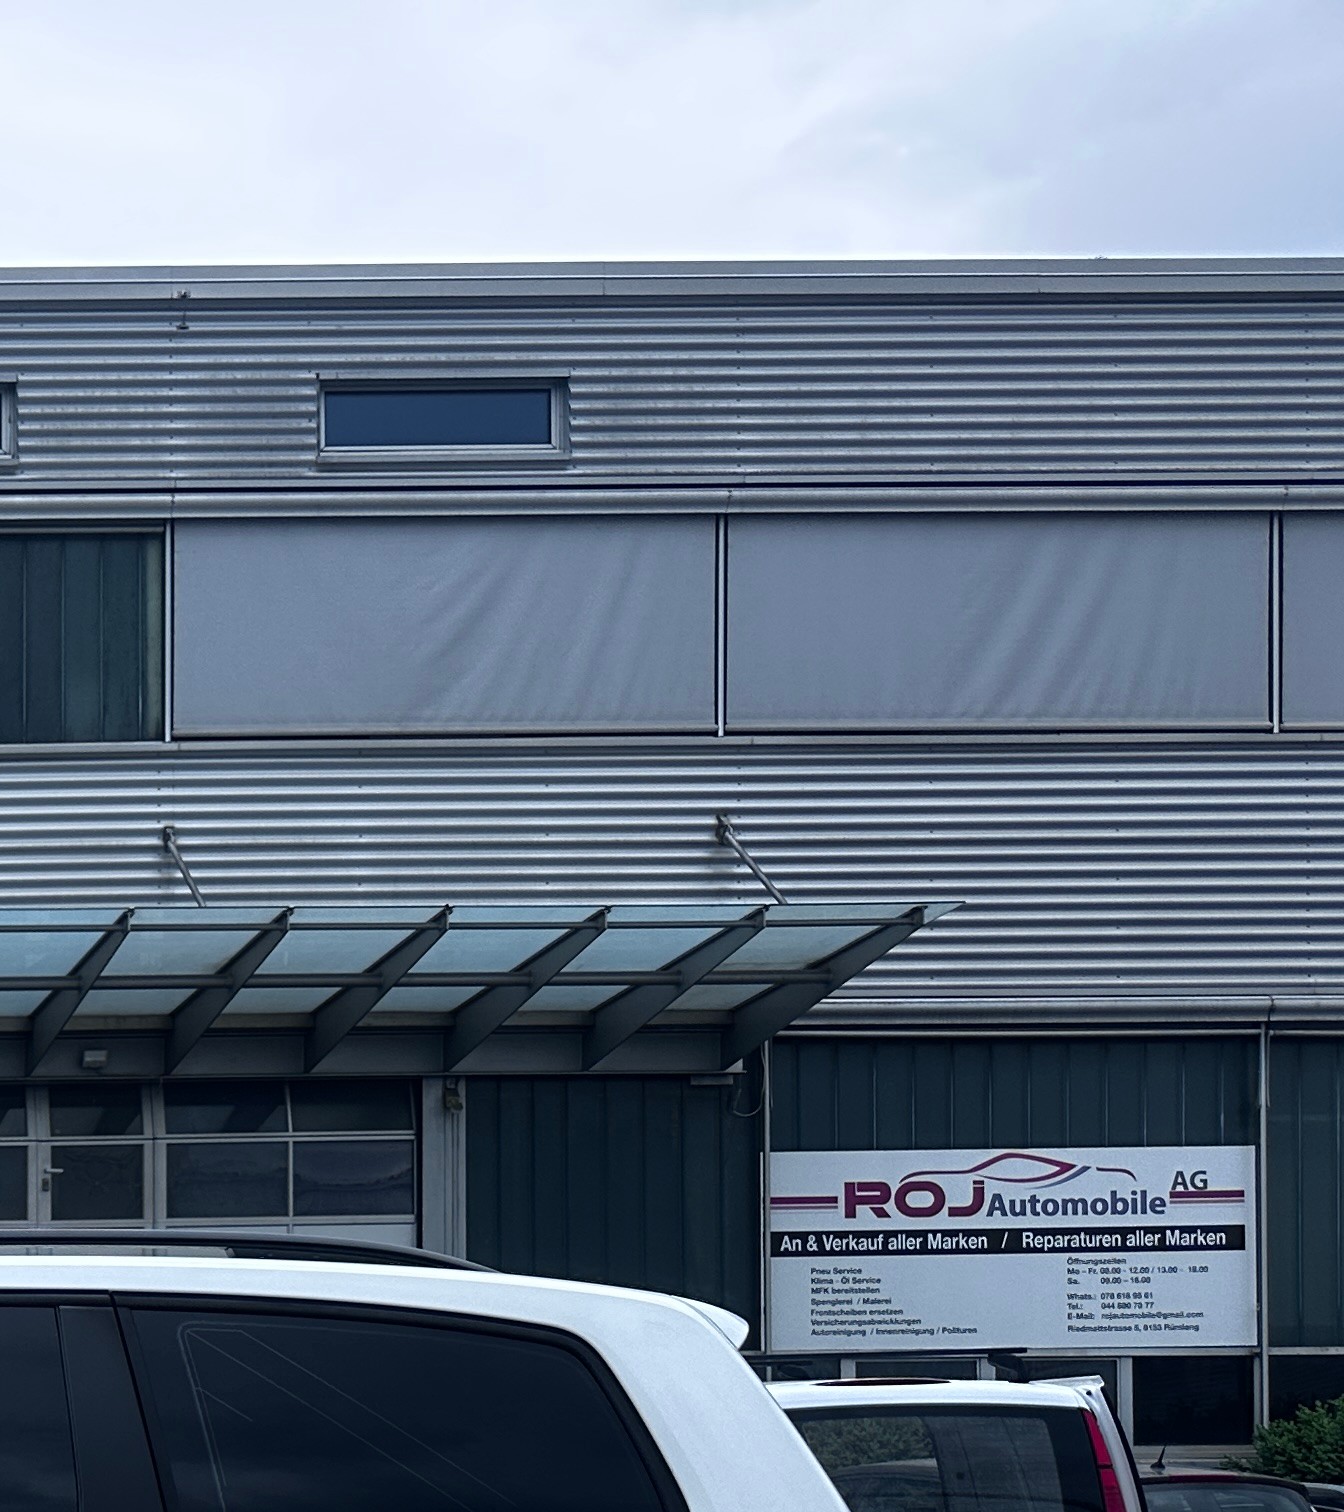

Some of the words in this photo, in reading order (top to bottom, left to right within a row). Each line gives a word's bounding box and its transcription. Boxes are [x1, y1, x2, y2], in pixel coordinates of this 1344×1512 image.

[844, 1180, 985, 1219] ROJ
[986, 1189, 1167, 1217] Automobile
[1171, 1170, 1208, 1190] AG
[780, 1235, 802, 1251] An
[806, 1235, 818, 1251] &
[822, 1234, 884, 1251] Verkauf
[887, 1233, 923, 1250] aller
[928, 1233, 988, 1250] Marken
[1001, 1231, 1008, 1249] /
[1022, 1231, 1122, 1251] Reparaturen
[1126, 1230, 1161, 1248] aller
[1165, 1229, 1226, 1247] Marken
[833, 1267, 862, 1275] Service
[811, 1277, 833, 1285] Klima
